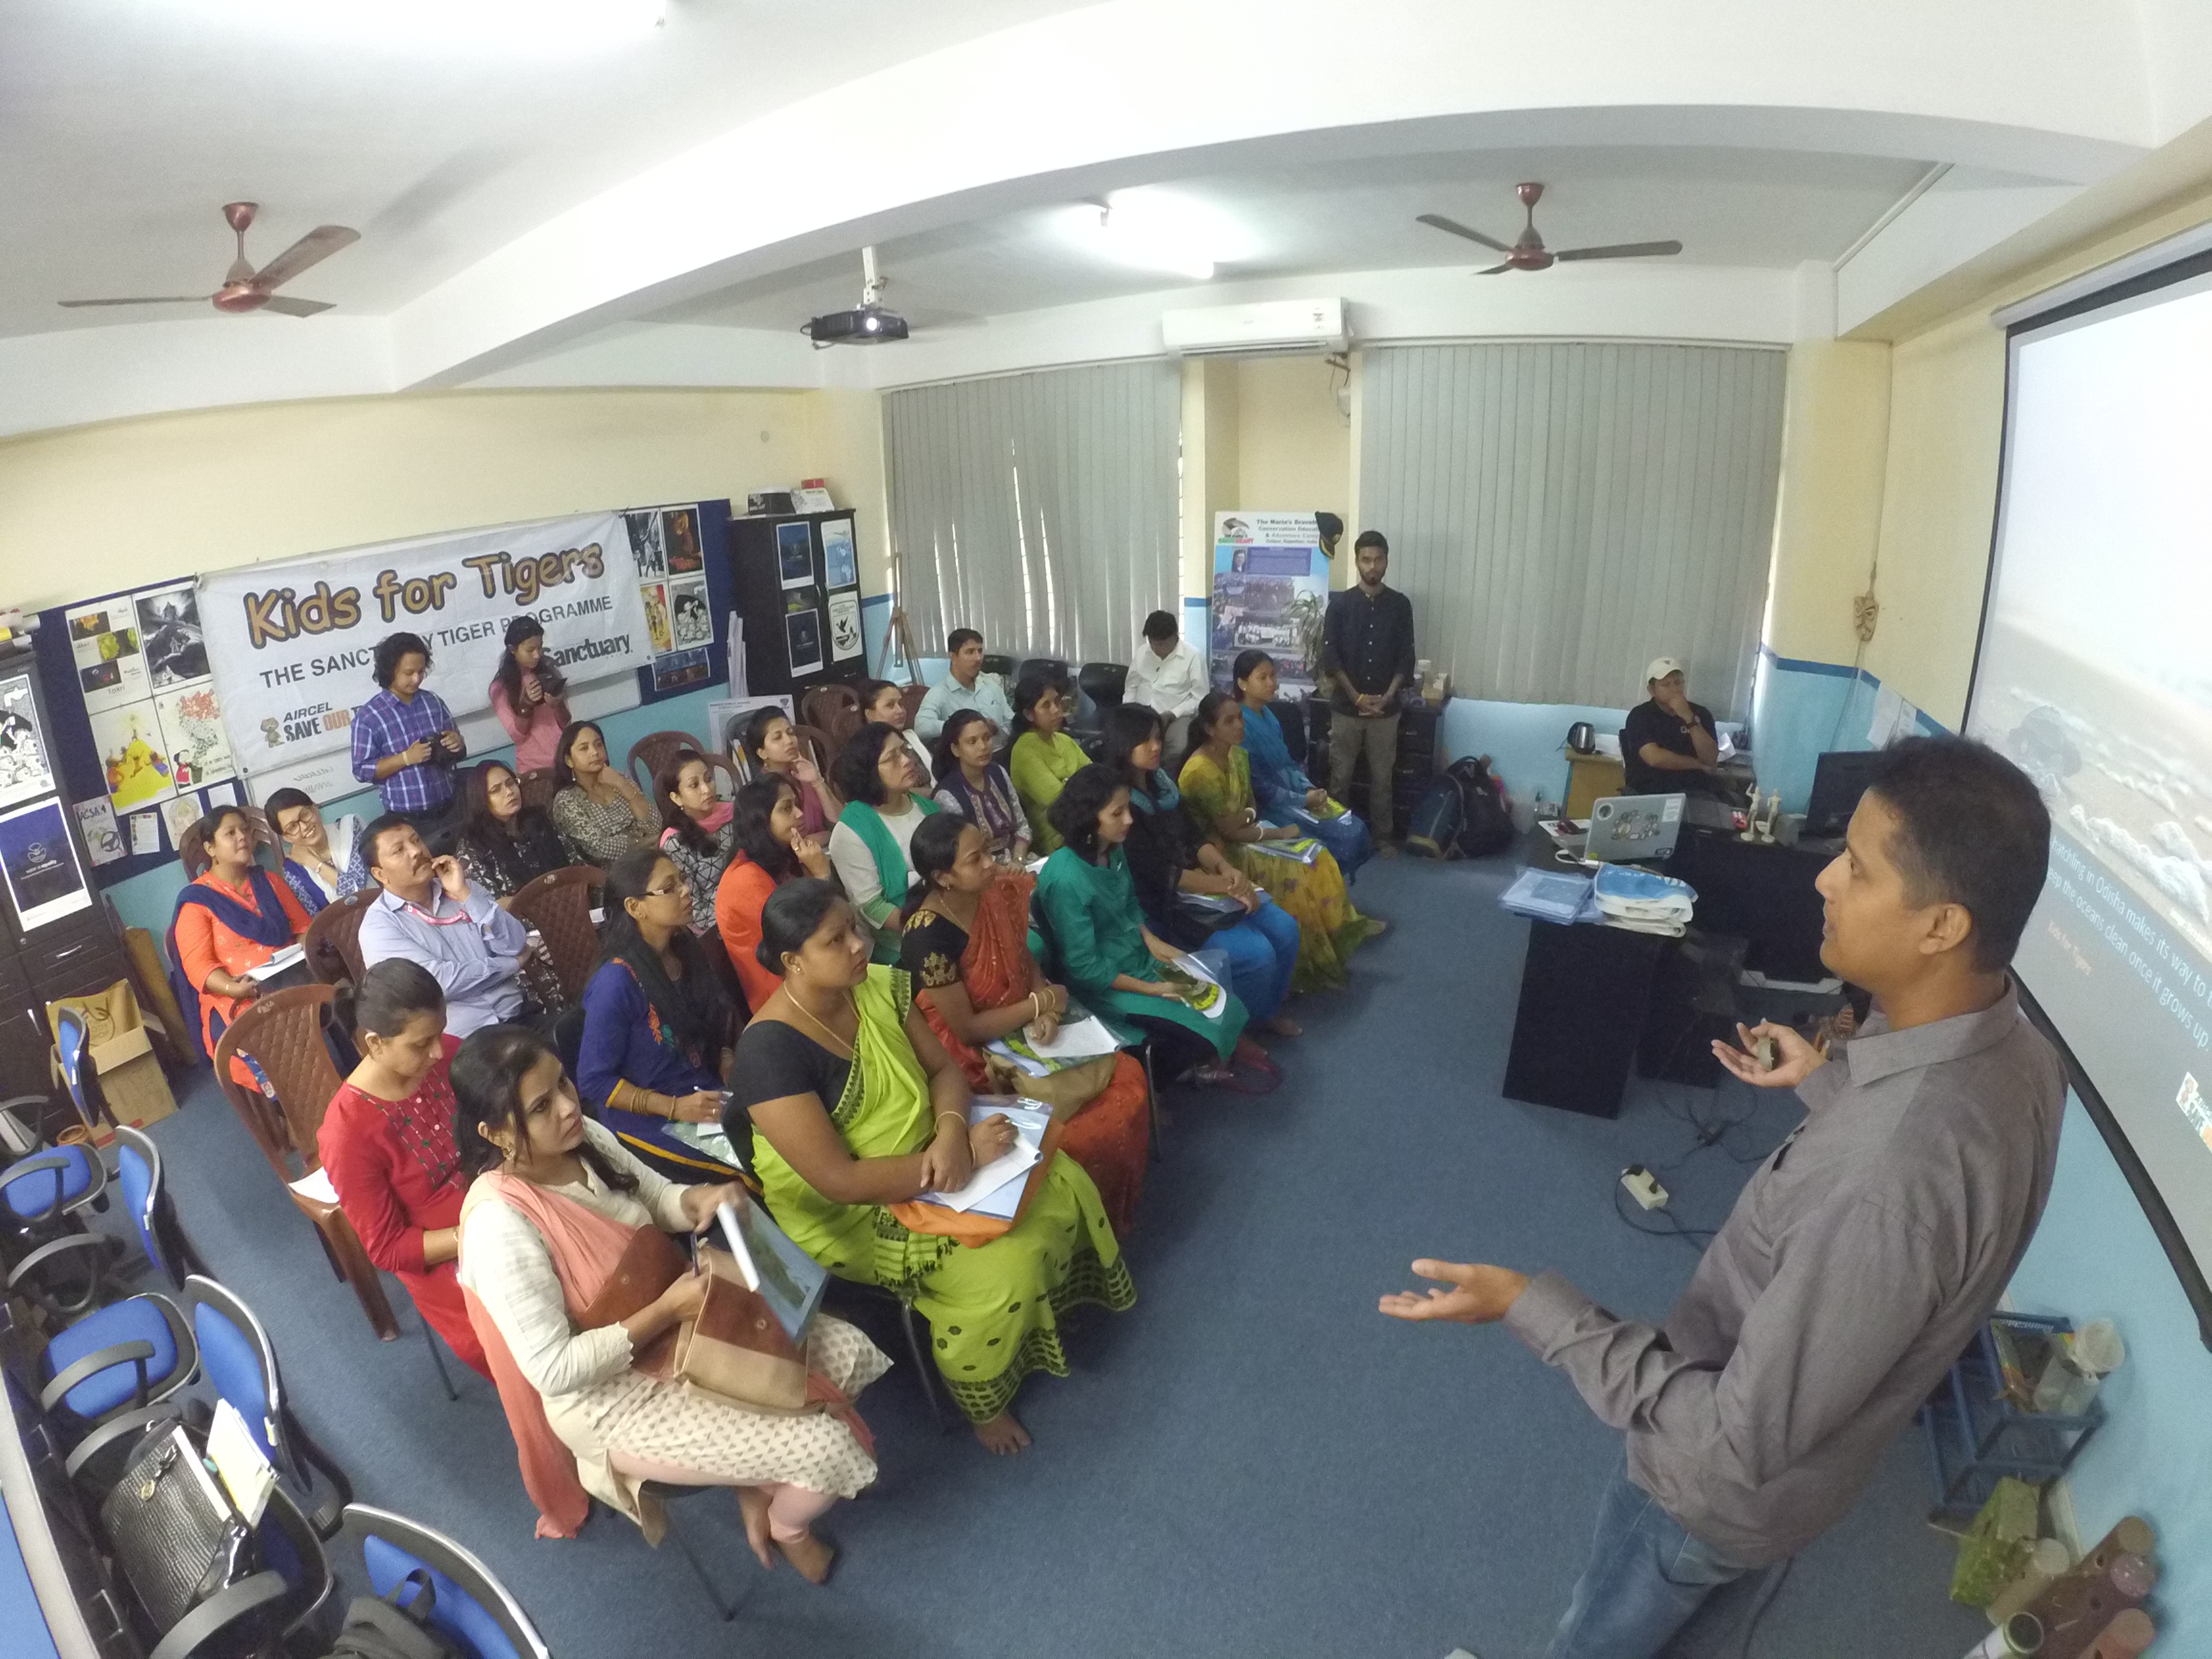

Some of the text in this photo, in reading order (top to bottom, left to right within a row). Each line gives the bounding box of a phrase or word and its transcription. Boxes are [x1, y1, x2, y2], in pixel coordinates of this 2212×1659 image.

[243, 542, 604, 649] Kids for Tigers
[260, 596, 613, 688] THE SANCY TIGER POGRAMME
[543, 634, 630, 668] Sanctuary
[283, 702, 333, 722] AIRCEL
[283, 717, 322, 742] SAVE
[323, 709, 351, 731] OUR
[2047, 866, 2062, 889] eep
[2062, 879, 2076, 902] the
[2076, 896, 2104, 931] oceans
[2104, 924, 2128, 956] clean
[2129, 951, 2153, 983] once
[2152, 972, 2162, 994] it
[2159, 987, 2193, 1029] grows
[2051, 836, 2206, 997] hatchling in Odisha makes its way to
